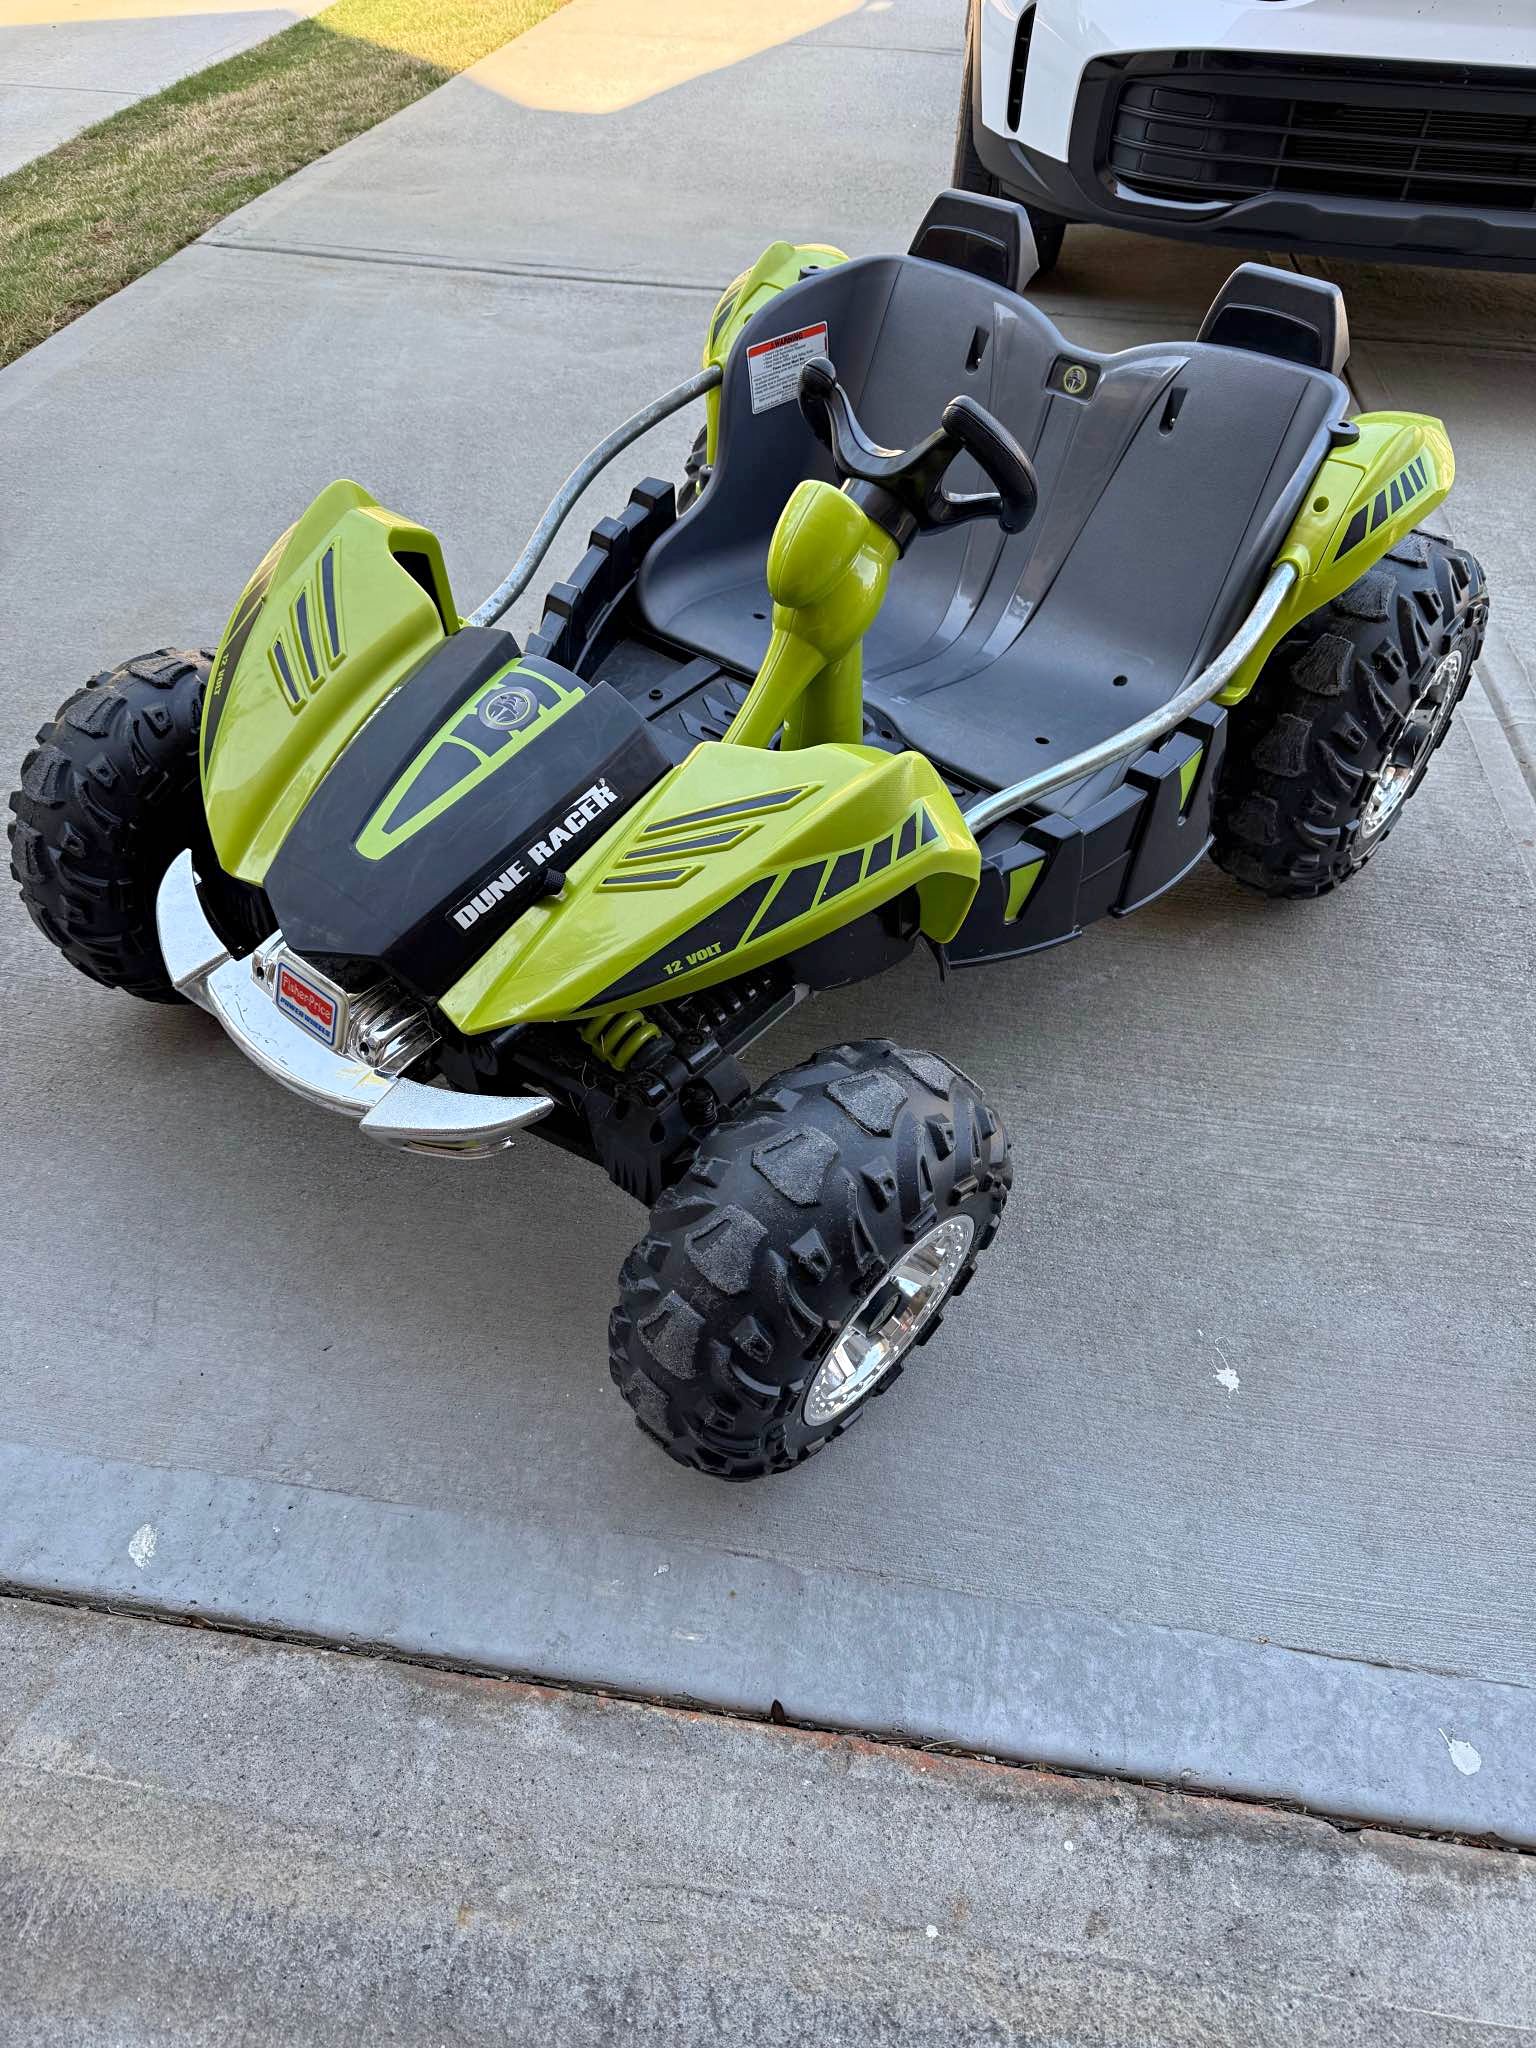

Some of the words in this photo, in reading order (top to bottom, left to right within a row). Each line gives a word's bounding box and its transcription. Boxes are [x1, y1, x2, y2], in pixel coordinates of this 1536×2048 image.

[775, 332, 803, 347] WARNING
[452, 859, 531, 930] DUNE
[527, 783, 619, 866] RACER
[663, 960, 684, 975] 12
[686, 941, 722, 965] VOLT
